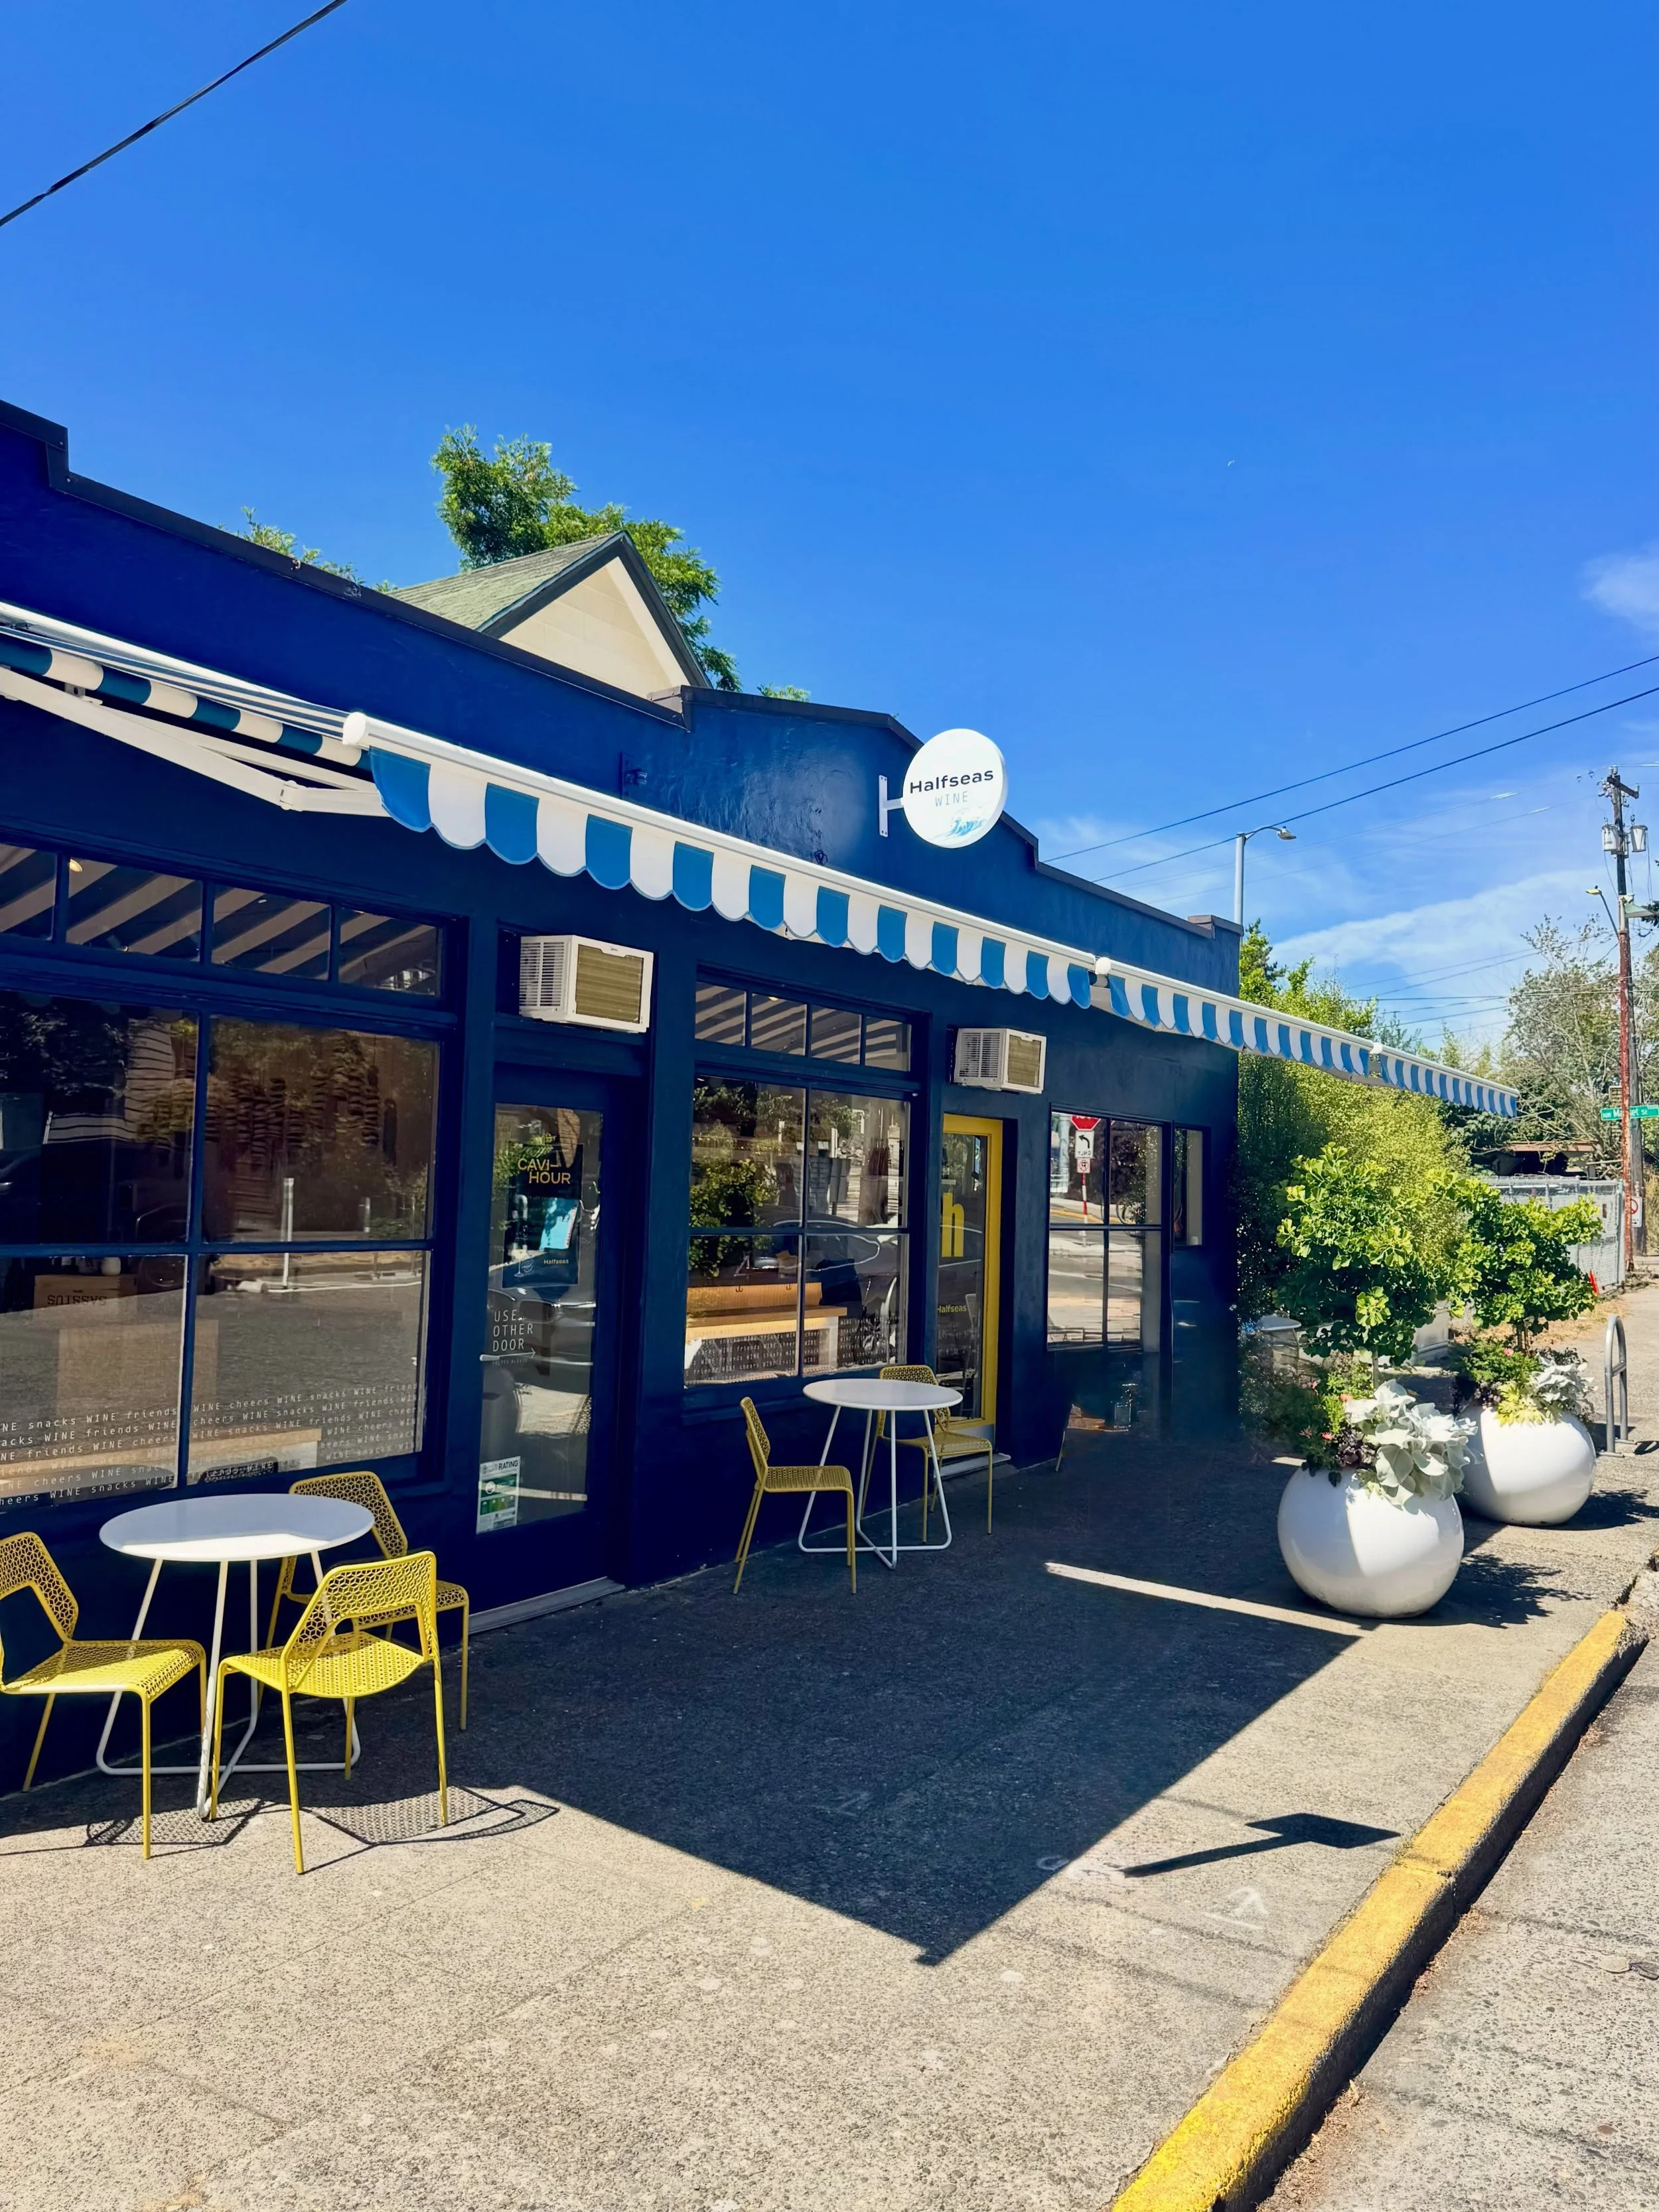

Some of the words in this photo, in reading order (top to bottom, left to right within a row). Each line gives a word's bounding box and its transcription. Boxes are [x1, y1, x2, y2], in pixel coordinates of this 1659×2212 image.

[910, 770, 994, 794] Halfseas
[935, 791, 969, 807] WINE
[1613, 1108, 1639, 1118] Maet
[528, 1171, 571, 1185] HOUR
[494, 1309, 517, 1322] USE
[493, 1323, 534, 1337] OTHER
[493, 1338, 524, 1352] DOOR
[194, 1402, 220, 1412] WINE
[230, 1398, 269, 1409] cheers
[277, 1394, 302, 1404] WINE
[311, 1391, 346, 1400] snacks
[354, 1386, 376, 1395] WINE
[29, 1418, 76, 1430] snacks
[86, 1413, 116, 1424] WINE
[127, 1408, 177, 1419] friends
[194, 1416, 234, 1426] cheers
[243, 1410, 269, 1420] WINE
[277, 1406, 314, 1417] snacks
[323, 1402, 345, 1411] WINE
[354, 1396, 394, 1407] friends
[192, 1429, 219, 1439] WINE
[229, 1425, 267, 1436] snacks
[275, 1420, 301, 1430] WINE
[310, 1414, 351, 1425] friends
[359, 1410, 382, 1419] WINE
[327, 1426, 350, 1436] WINE
[358, 1422, 393, 1432] cheers
[0, 1436, 33, 1447] acks
[44, 1431, 75, 1441] WINE
[86, 1425, 139, 1438] friends
[149, 1421, 176, 1431] WINE
[321, 1439, 350, 1447] heers
[358, 1434, 381, 1443] WINE
[27, 1445, 83, 1458] friends
[93, 1439, 123, 1451] WINE
[133, 1435, 175, 1446] cheers
[498, 1460, 518, 1470] RATING
[34, 1474, 81, 1487] cheers
[92, 1467, 121, 1479] WINE
[50, 1487, 80, 1499] WINE
[92, 1481, 135, 1493] snacks
[146, 1475, 174, 1486] WINE
